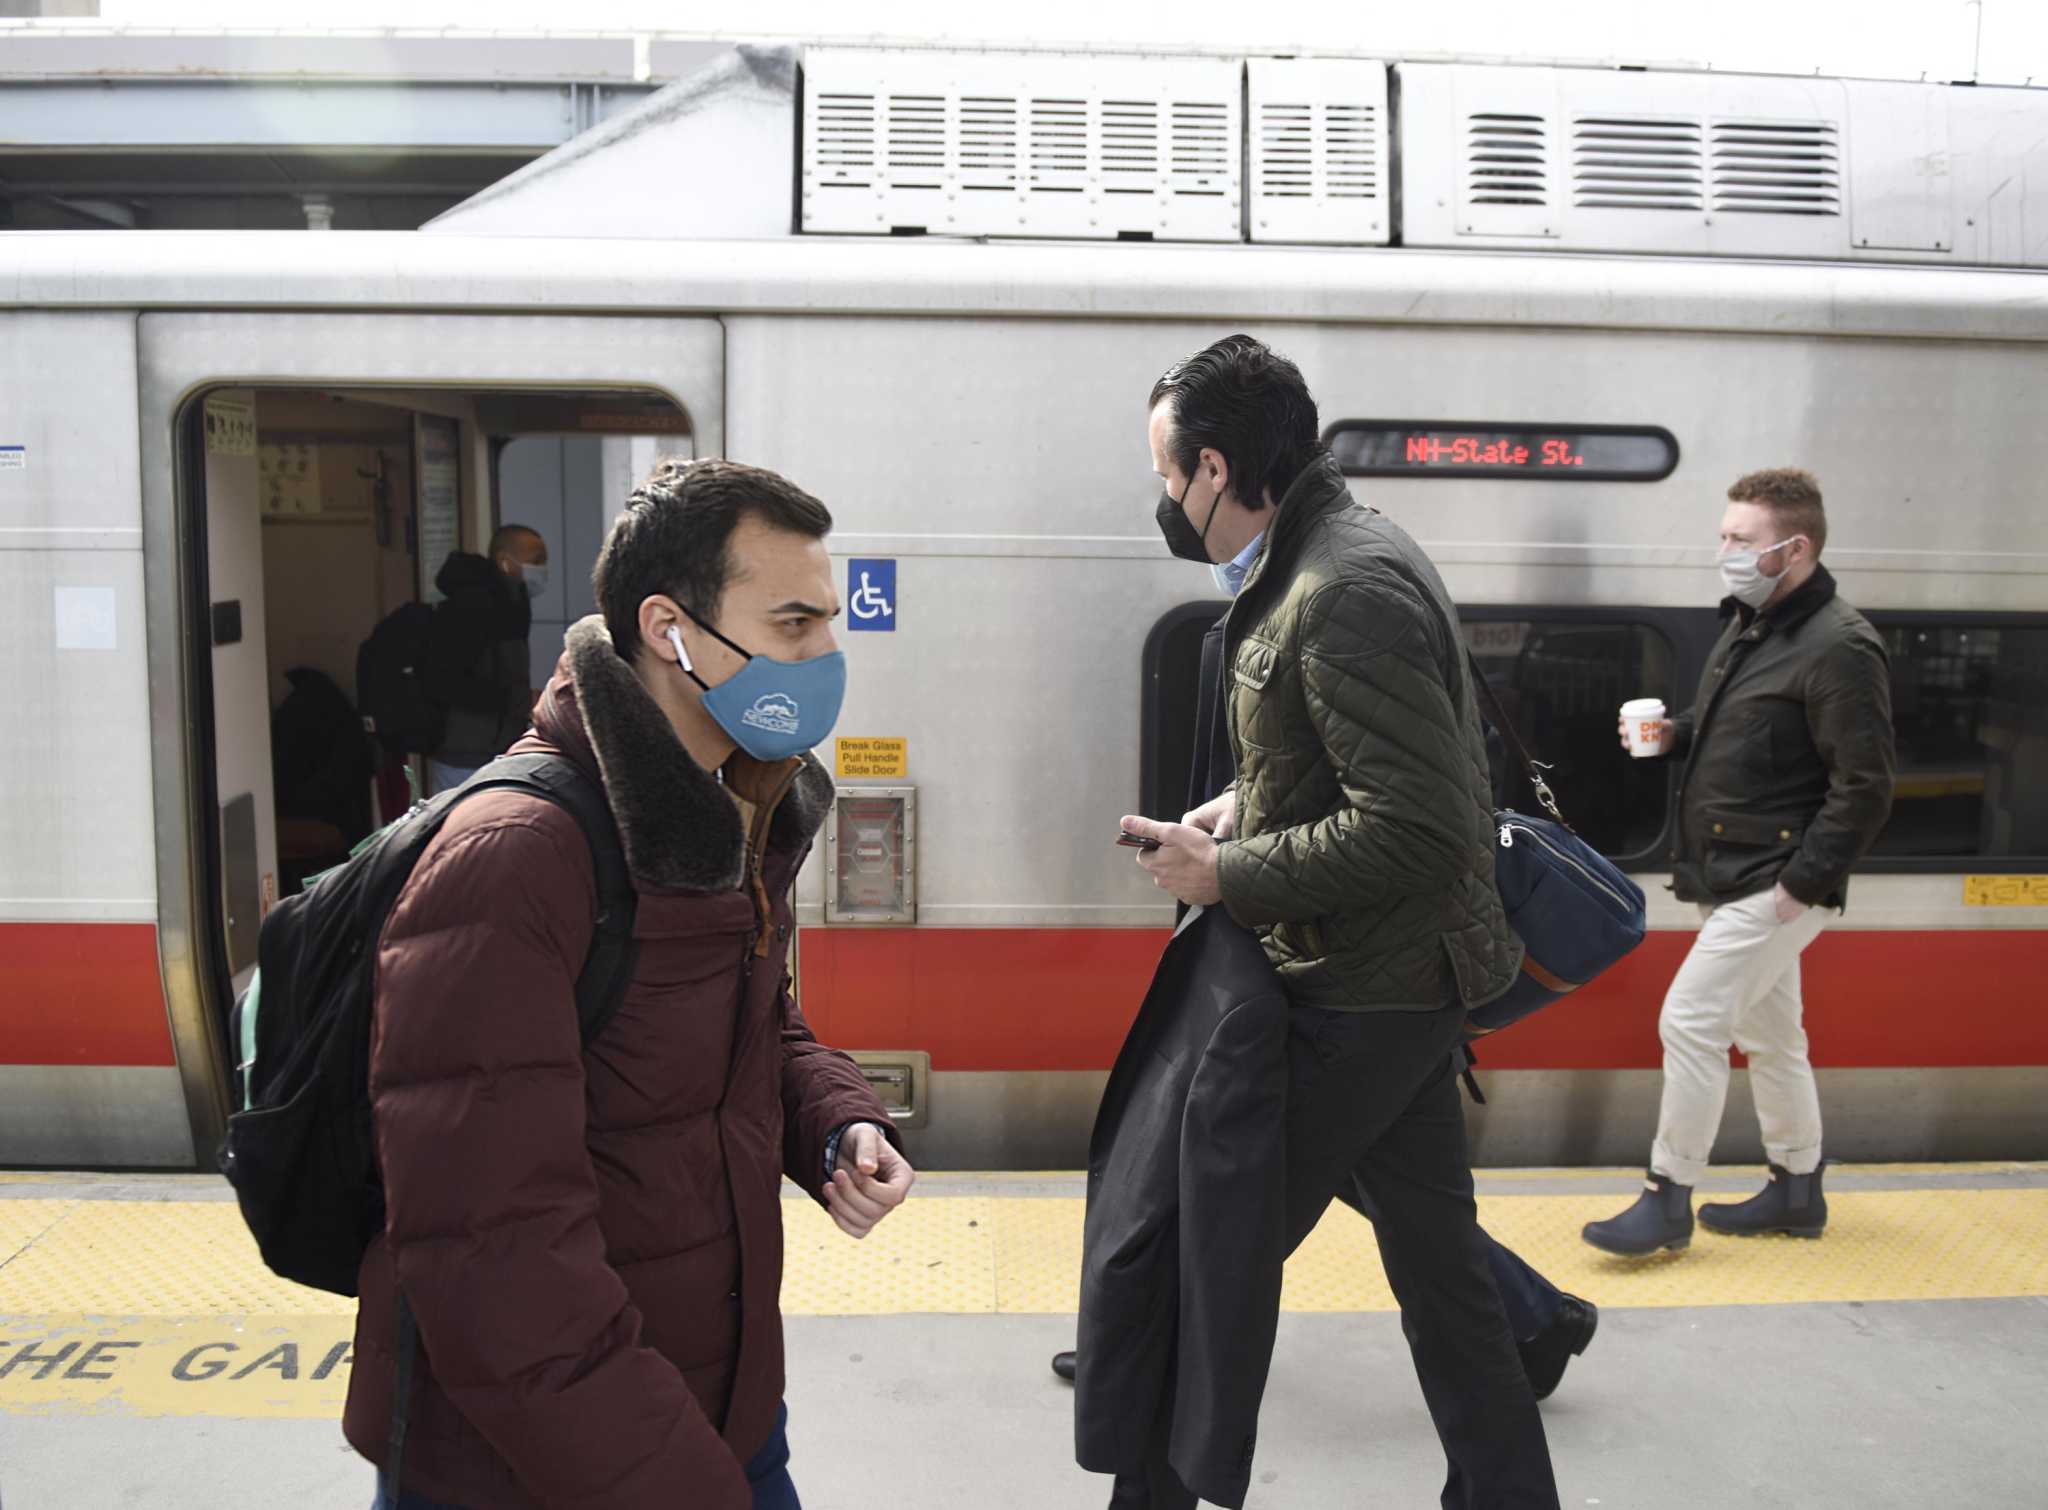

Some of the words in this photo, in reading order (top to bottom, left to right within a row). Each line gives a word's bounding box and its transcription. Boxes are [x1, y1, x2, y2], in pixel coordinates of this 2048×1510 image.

[1407, 437, 1529, 465] NH-State
[1541, 440, 1583, 466] St.
[840, 740, 869, 751] Break
[872, 740, 902, 751] Glass
[843, 753, 862, 763] Pull
[864, 753, 899, 763] Handle
[844, 765, 870, 775] Slide
[872, 765, 897, 775] Door
[0, 1341, 143, 1380] HE
